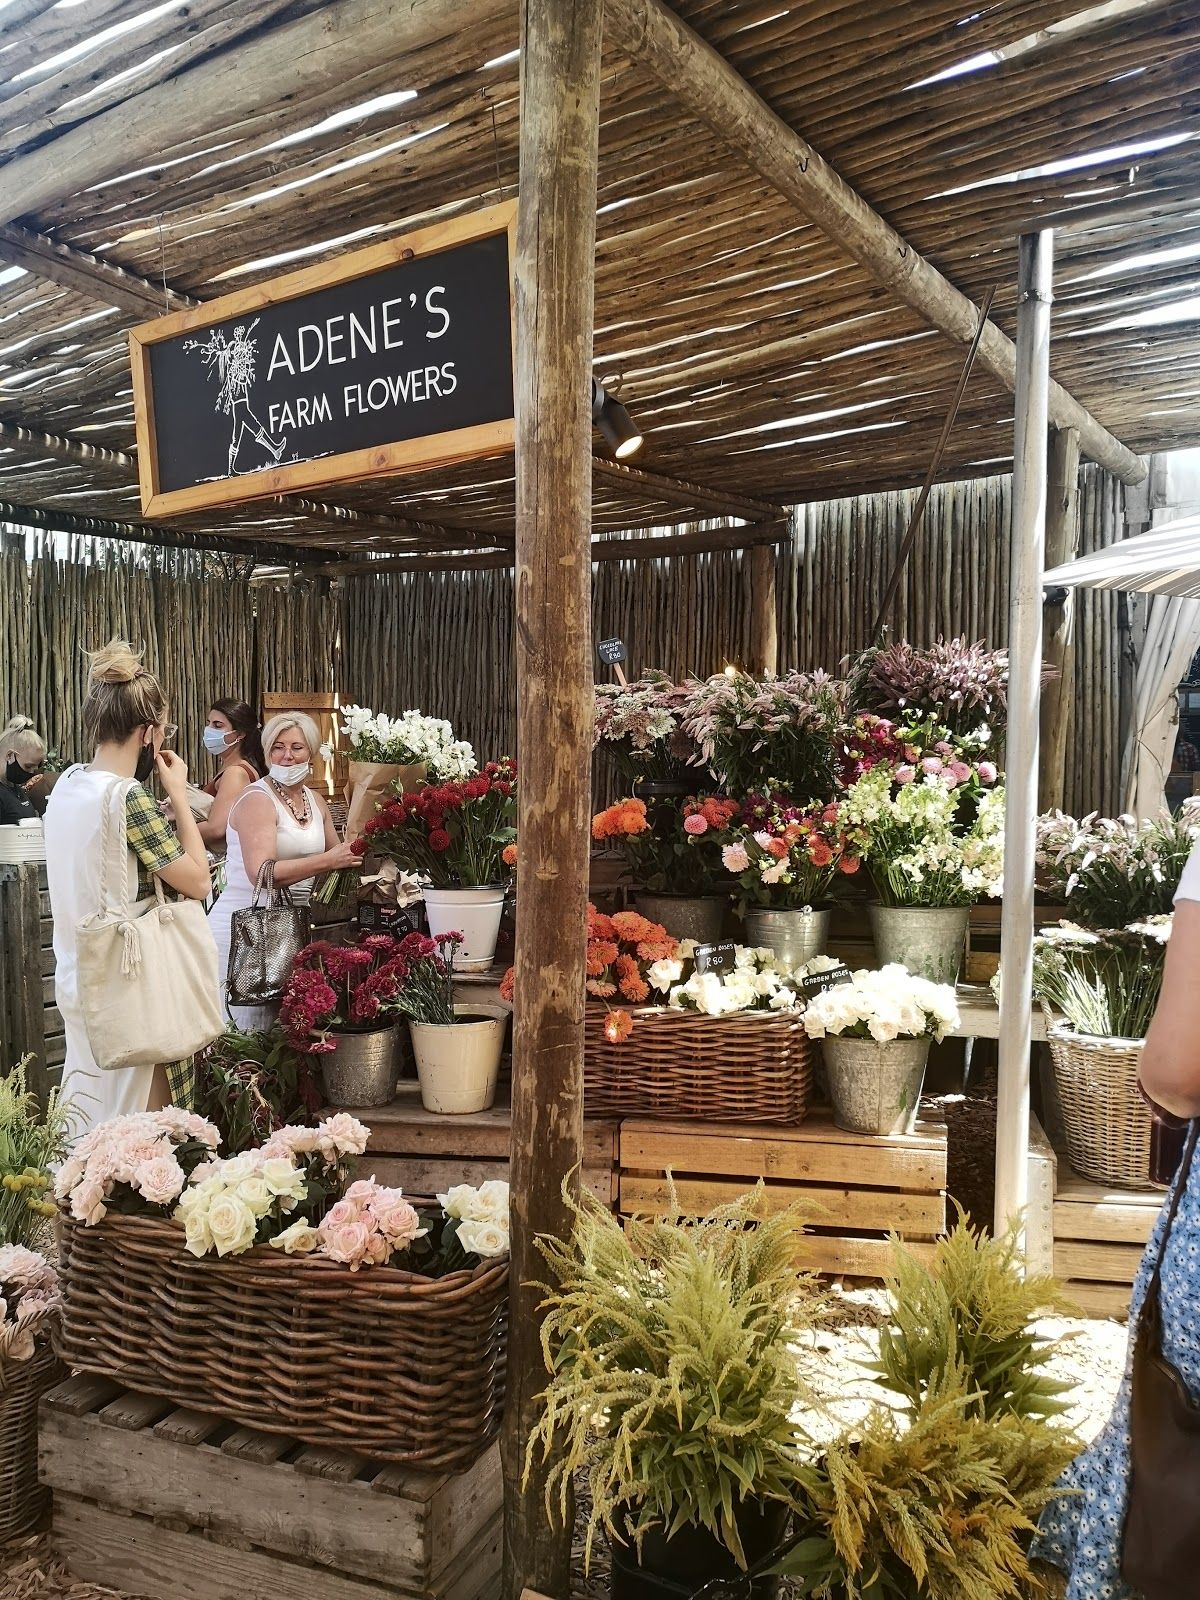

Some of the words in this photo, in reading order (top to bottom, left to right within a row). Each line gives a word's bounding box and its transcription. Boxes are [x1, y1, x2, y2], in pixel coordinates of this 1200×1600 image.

[266, 285, 451, 381] ADENE'S
[268, 393, 333, 434] FARM
[344, 362, 458, 417] FLOWERS
[695, 947, 717, 957] GARDEN
[718, 943, 734, 951] ROSES
[706, 956, 724, 969] R80
[804, 974, 830, 986] GARDEN
[831, 969, 849, 979] ROSES
